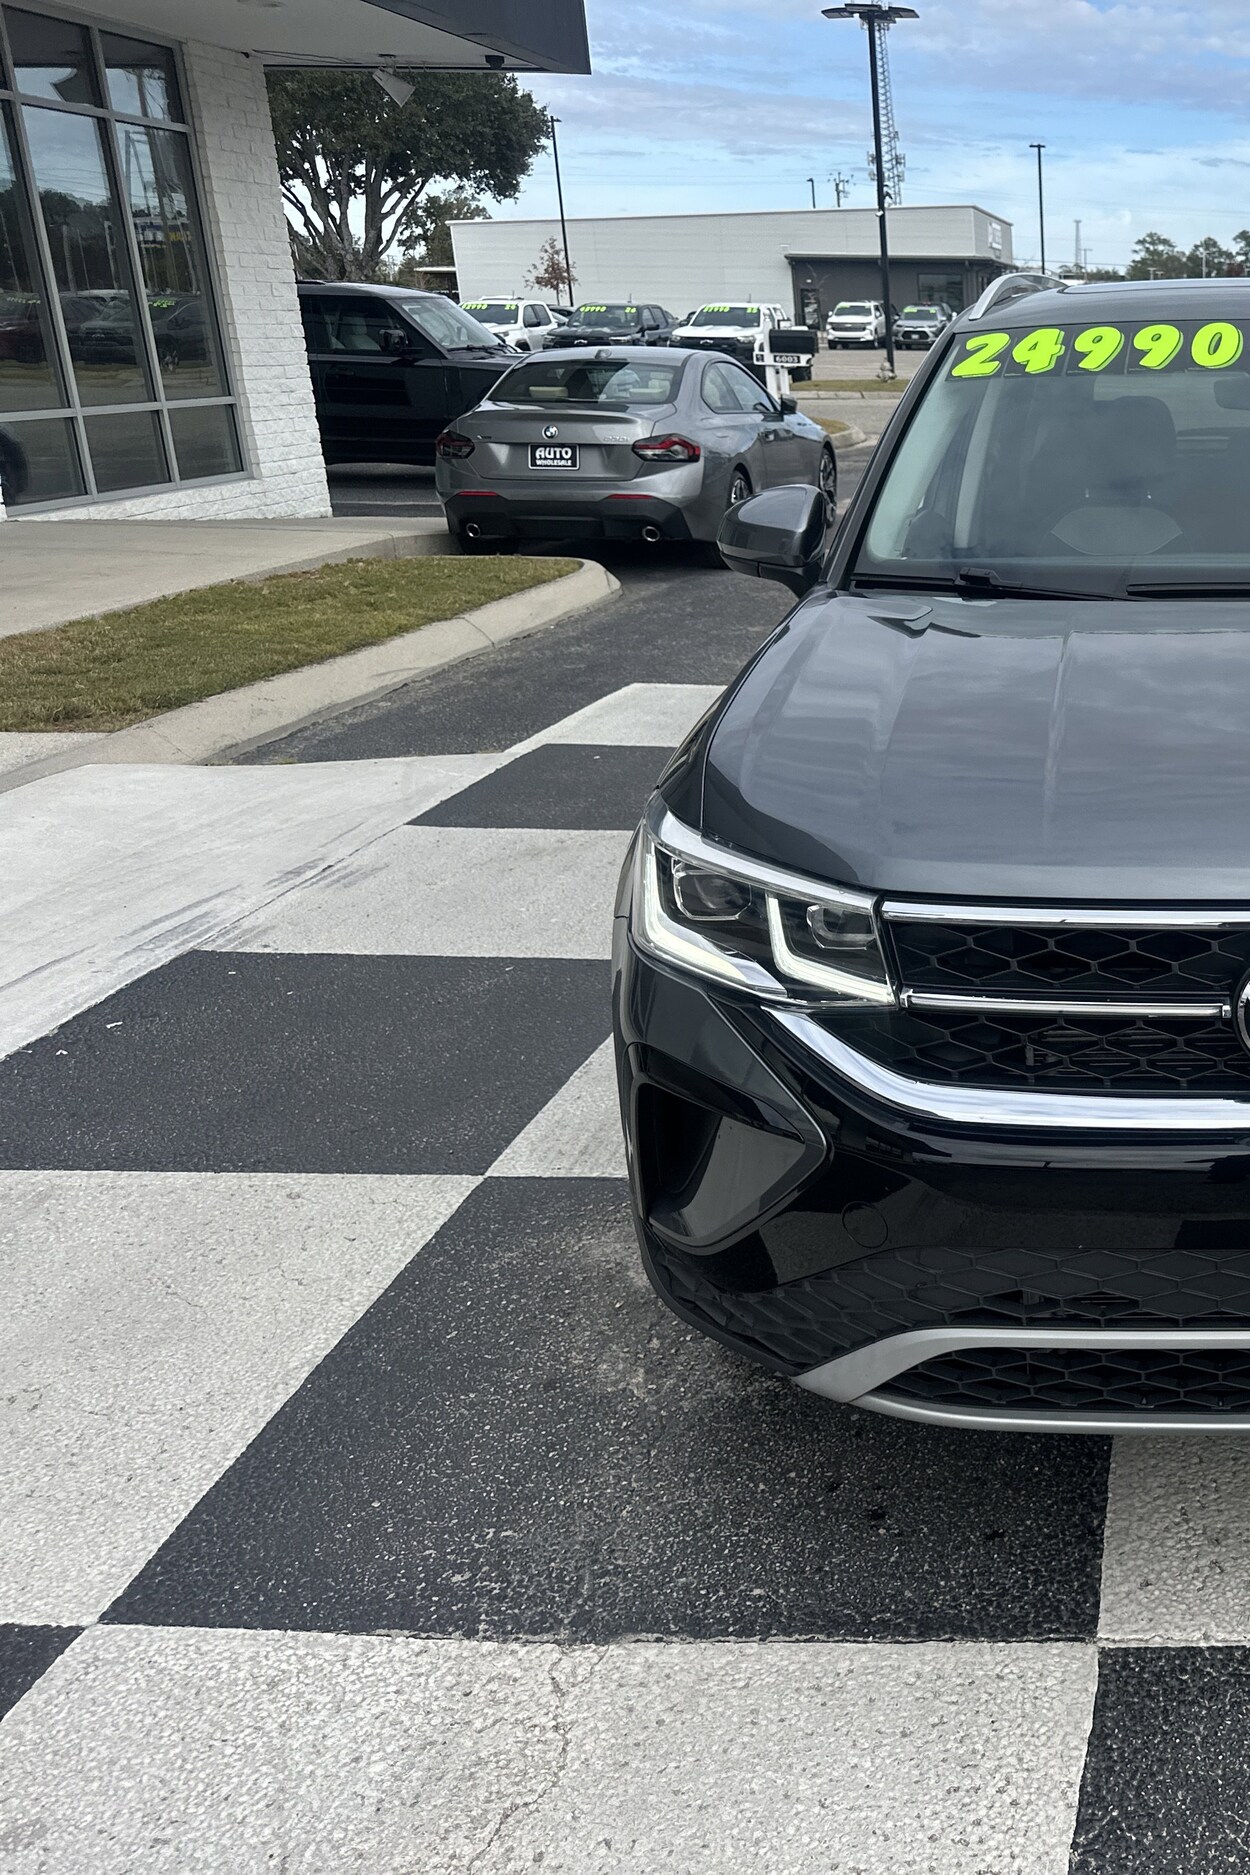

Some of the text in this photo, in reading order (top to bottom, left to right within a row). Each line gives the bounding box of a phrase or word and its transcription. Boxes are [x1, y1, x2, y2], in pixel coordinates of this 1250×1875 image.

[951, 321, 1244, 378] 24990
[775, 355, 799, 363] 6003
[535, 447, 572, 460] AUTO
